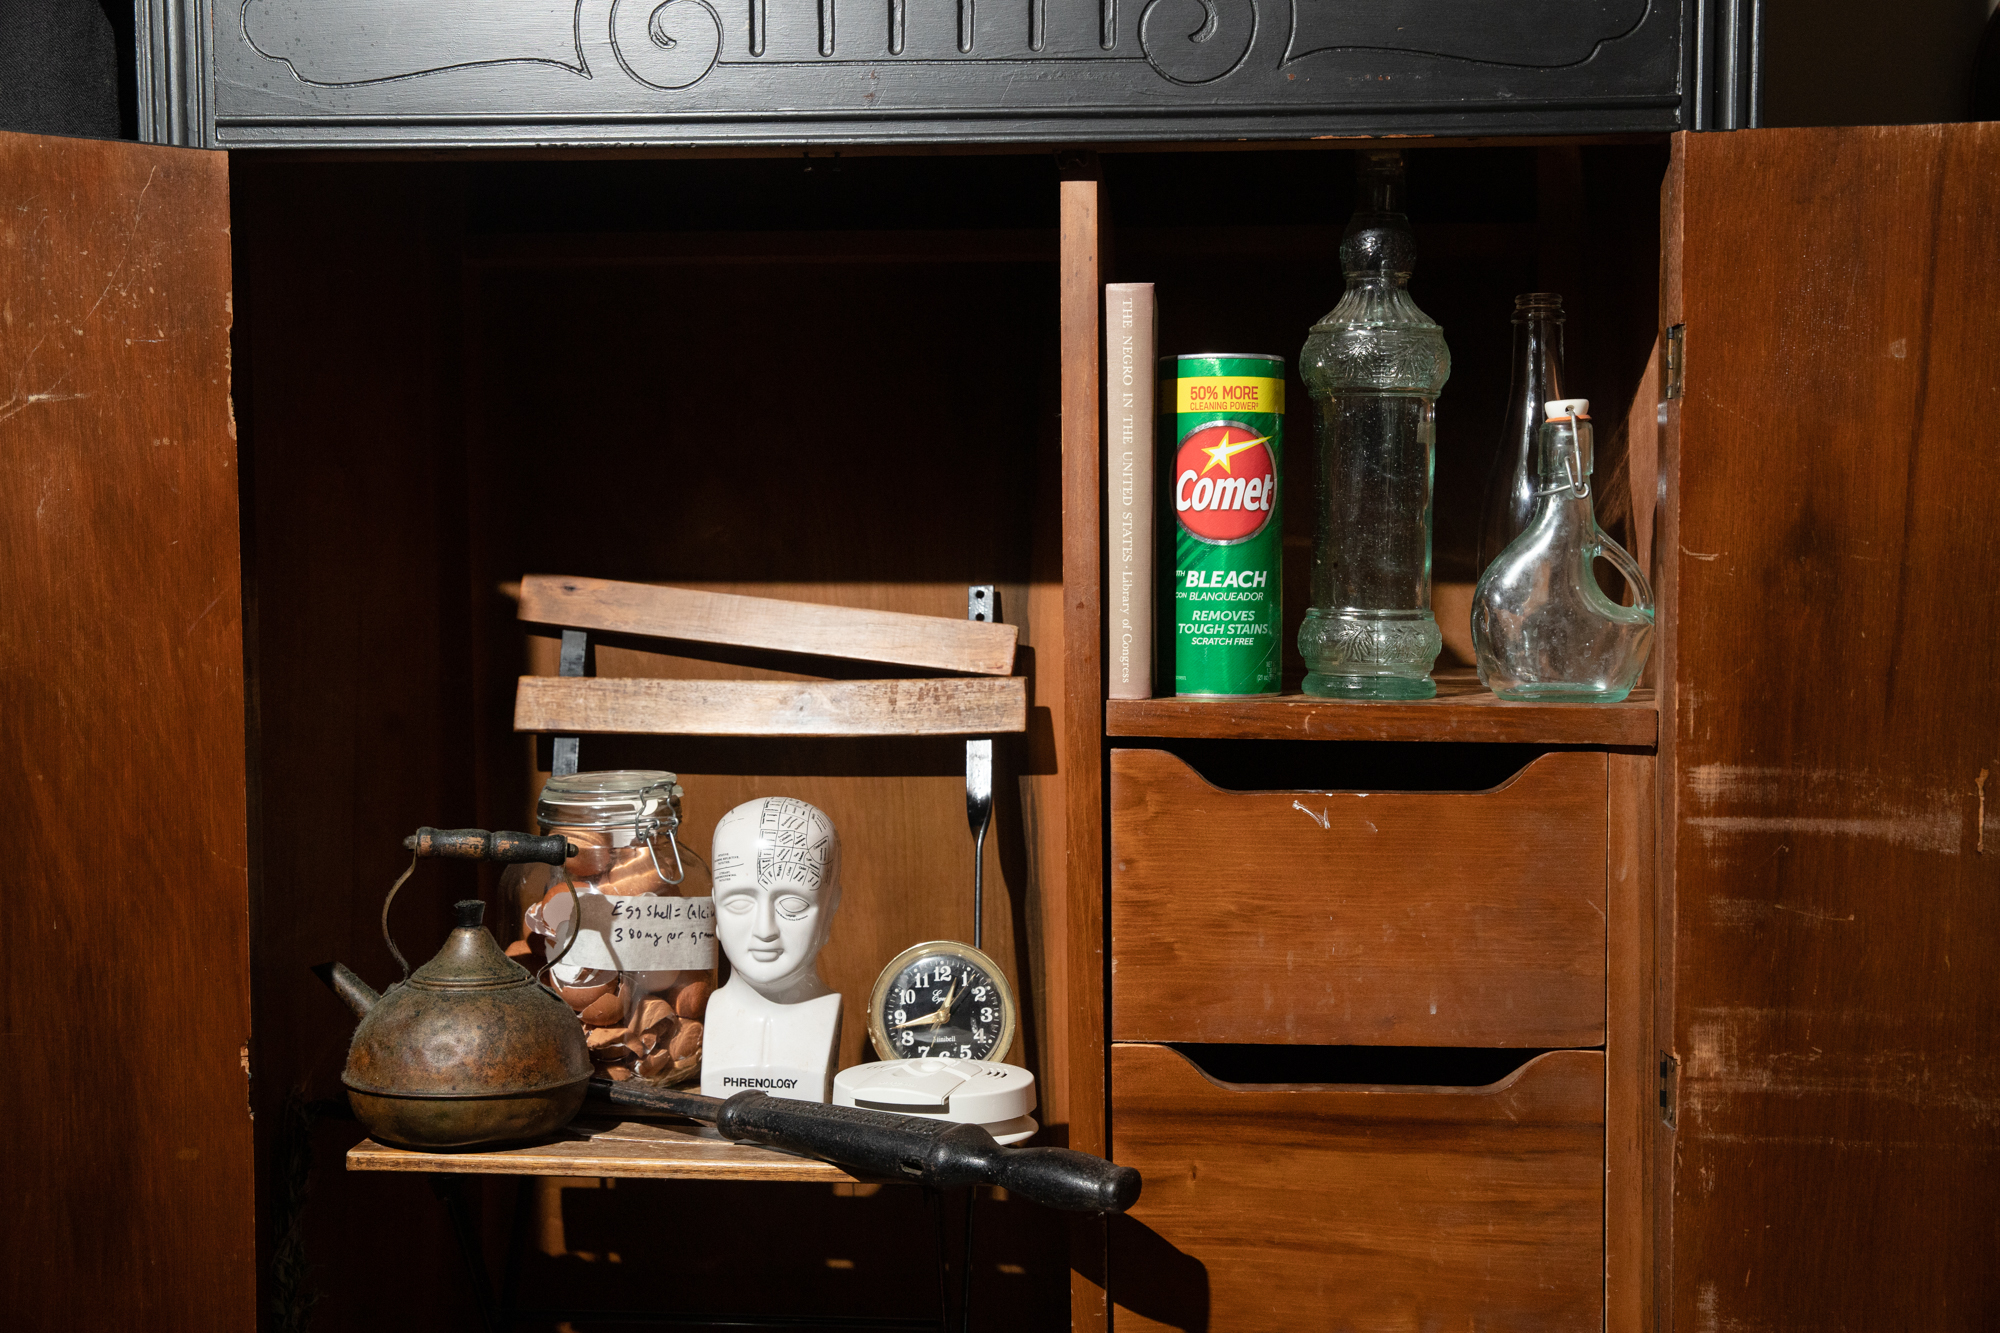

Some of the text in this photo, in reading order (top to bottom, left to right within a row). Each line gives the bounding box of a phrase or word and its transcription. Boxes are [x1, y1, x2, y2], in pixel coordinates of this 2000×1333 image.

[1190, 385, 1259, 400] 50% MORE
[1190, 401, 1228, 411] CLEANING
[1119, 297, 1133, 684] THE NEGRO IN THE UNITED STATES Library of Congress
[1176, 469, 1274, 512] Comet
[1185, 570, 1268, 588] BLEACH
[1189, 591, 1264, 601] BLANQUEADOR
[1192, 610, 1256, 621] REMOVES
[1178, 623, 1269, 635] TOUGH STAINS
[1191, 637, 1254, 646] SCRATCH FREE
[611, 900, 641, 920] Egg
[915, 972, 930, 988] 11
[933, 965, 952, 982] 12
[961, 971, 969, 987] 1
[899, 989, 916, 1005] 10
[971, 986, 987, 1002] 2
[893, 1009, 907, 1025] 9
[980, 1007, 993, 1023] 3
[901, 1030, 915, 1046] 8
[973, 1028, 987, 1044] 4
[918, 1046, 930, 1059] 7
[959, 1044, 972, 1060] 5
[723, 1076, 798, 1089] PHRENOLOGY
